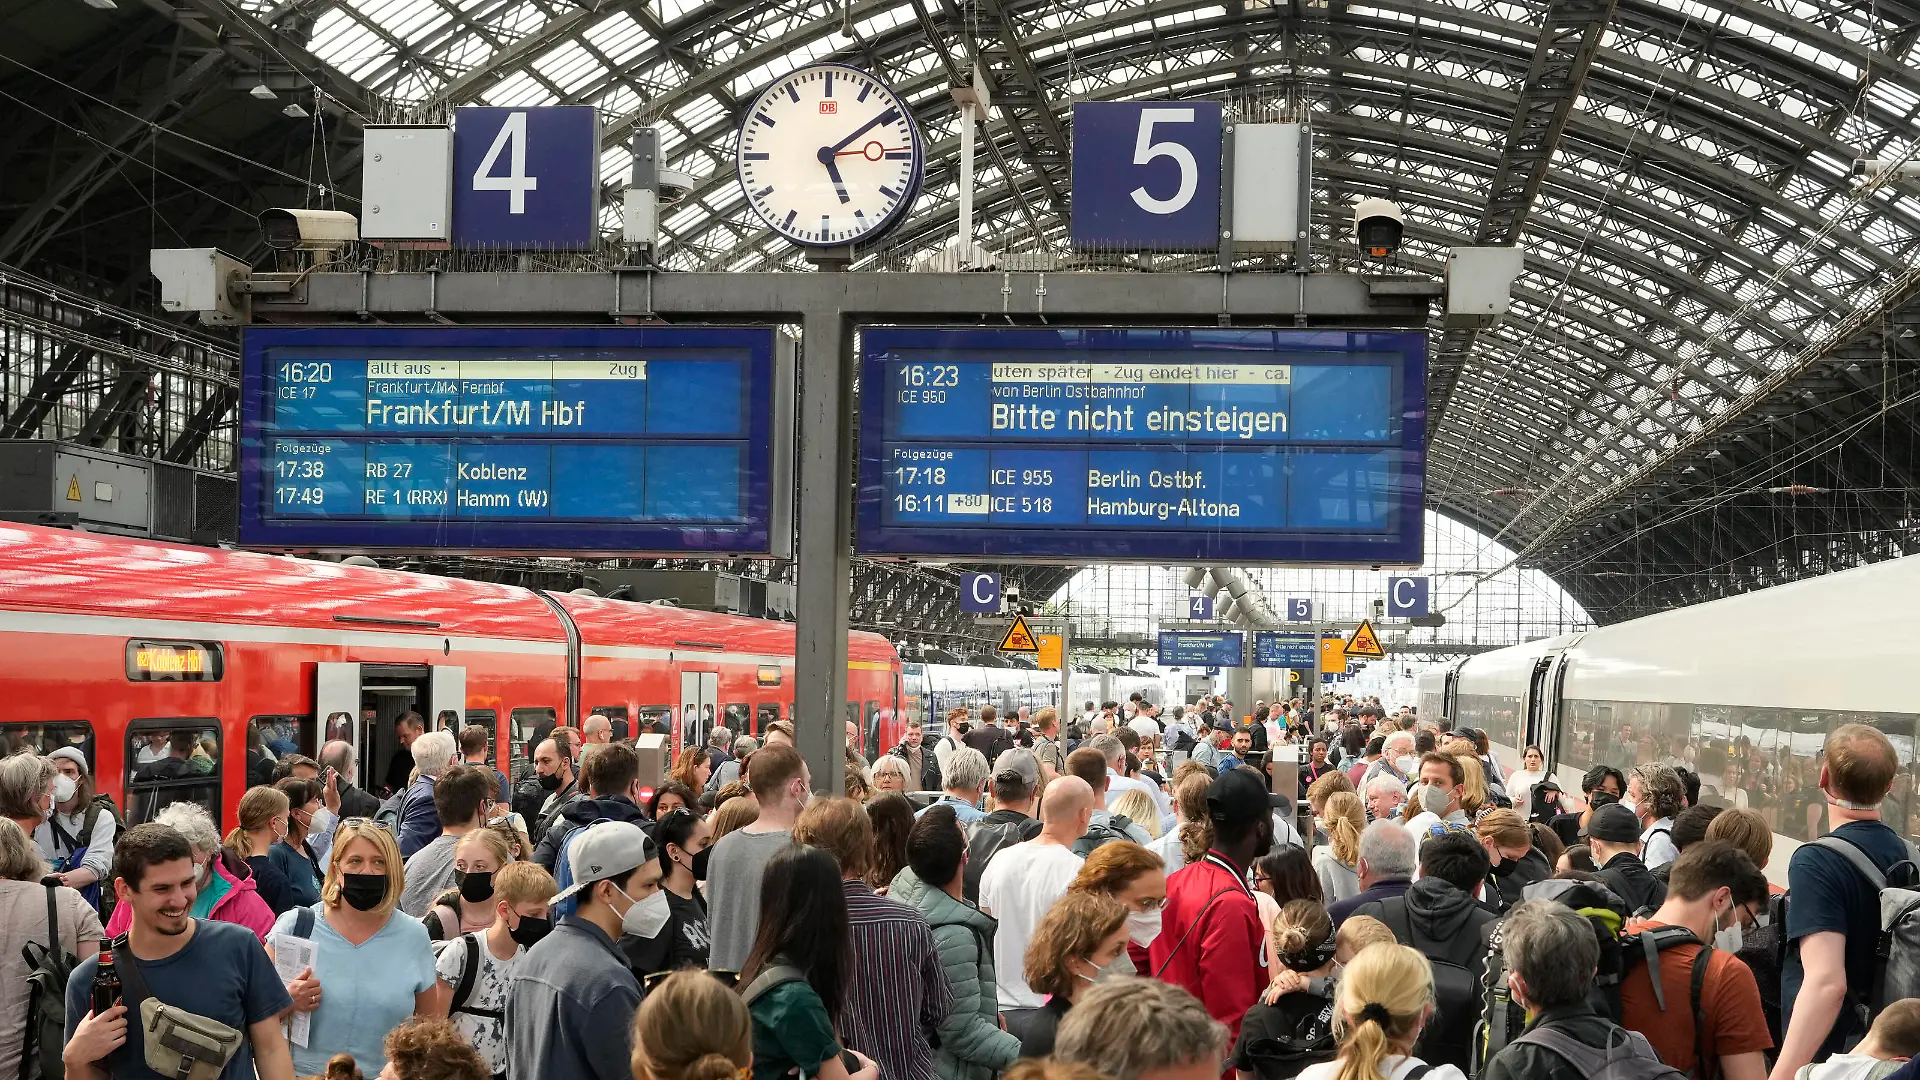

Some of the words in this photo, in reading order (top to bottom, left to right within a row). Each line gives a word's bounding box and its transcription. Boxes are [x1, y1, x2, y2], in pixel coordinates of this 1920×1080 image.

[822, 103, 835, 112] DB
[473, 112, 537, 214] 4
[1130, 108, 1198, 214] 5
[281, 363, 332, 383] 16:20
[367, 362, 399, 375] ällt
[404, 364, 431, 375] aus
[609, 362, 637, 378] Zug
[899, 365, 959, 387] 16:23
[993, 366, 1032, 378] uten
[1038, 365, 1093, 382] später
[1114, 366, 1143, 382] Zug
[1149, 366, 1201, 380] endet
[1207, 367, 1239, 380] hier
[1264, 368, 1289, 380] ca.
[278, 387, 297, 399] ICE
[302, 387, 316, 399] 17
[462, 382, 504, 394] Fernbf
[898, 390, 918, 403] ICE
[922, 391, 946, 404] 950
[993, 387, 1019, 398] von
[1023, 385, 1061, 398] Berlin
[1065, 385, 1145, 399] Ostbahnhof
[367, 400, 530, 425] Frankfurt/M
[541, 400, 585, 425] Hbf
[992, 403, 1056, 430] Bitte
[1068, 404, 1134, 431] nicht
[1146, 405, 1287, 439] einsteigen
[275, 443, 331, 454] Folgezüge
[894, 449, 953, 460] Folgezüge
[276, 461, 324, 478] 17:38
[366, 463, 387, 478] RB
[393, 463, 412, 478] 27
[457, 462, 527, 480] Koblenz
[895, 467, 946, 485] 17:18
[991, 469, 1016, 485] ICE
[1022, 470, 1053, 485] 955
[1087, 469, 1141, 488] Berlin
[1149, 470, 1206, 489] Ostbf.
[276, 488, 324, 504] 17:49
[366, 490, 386, 504] RE
[392, 490, 400, 504] 1
[407, 490, 448, 505] (RRX)
[457, 490, 510, 507] Hamm
[517, 490, 548, 507] (W)
[894, 495, 943, 512] 16:11
[954, 495, 983, 508] +80
[990, 497, 1016, 513] ICE
[1022, 498, 1052, 513] 518
[1087, 497, 1240, 520] Hamburg-Altona
[972, 574, 994, 604] C
[1393, 577, 1416, 608] C
[1192, 597, 1205, 615] 4
[1295, 599, 1308, 616] 5
[149, 648, 185, 672] Koblenz
[187, 649, 202, 672] Hbf
[1345, 663, 1354, 675] D
